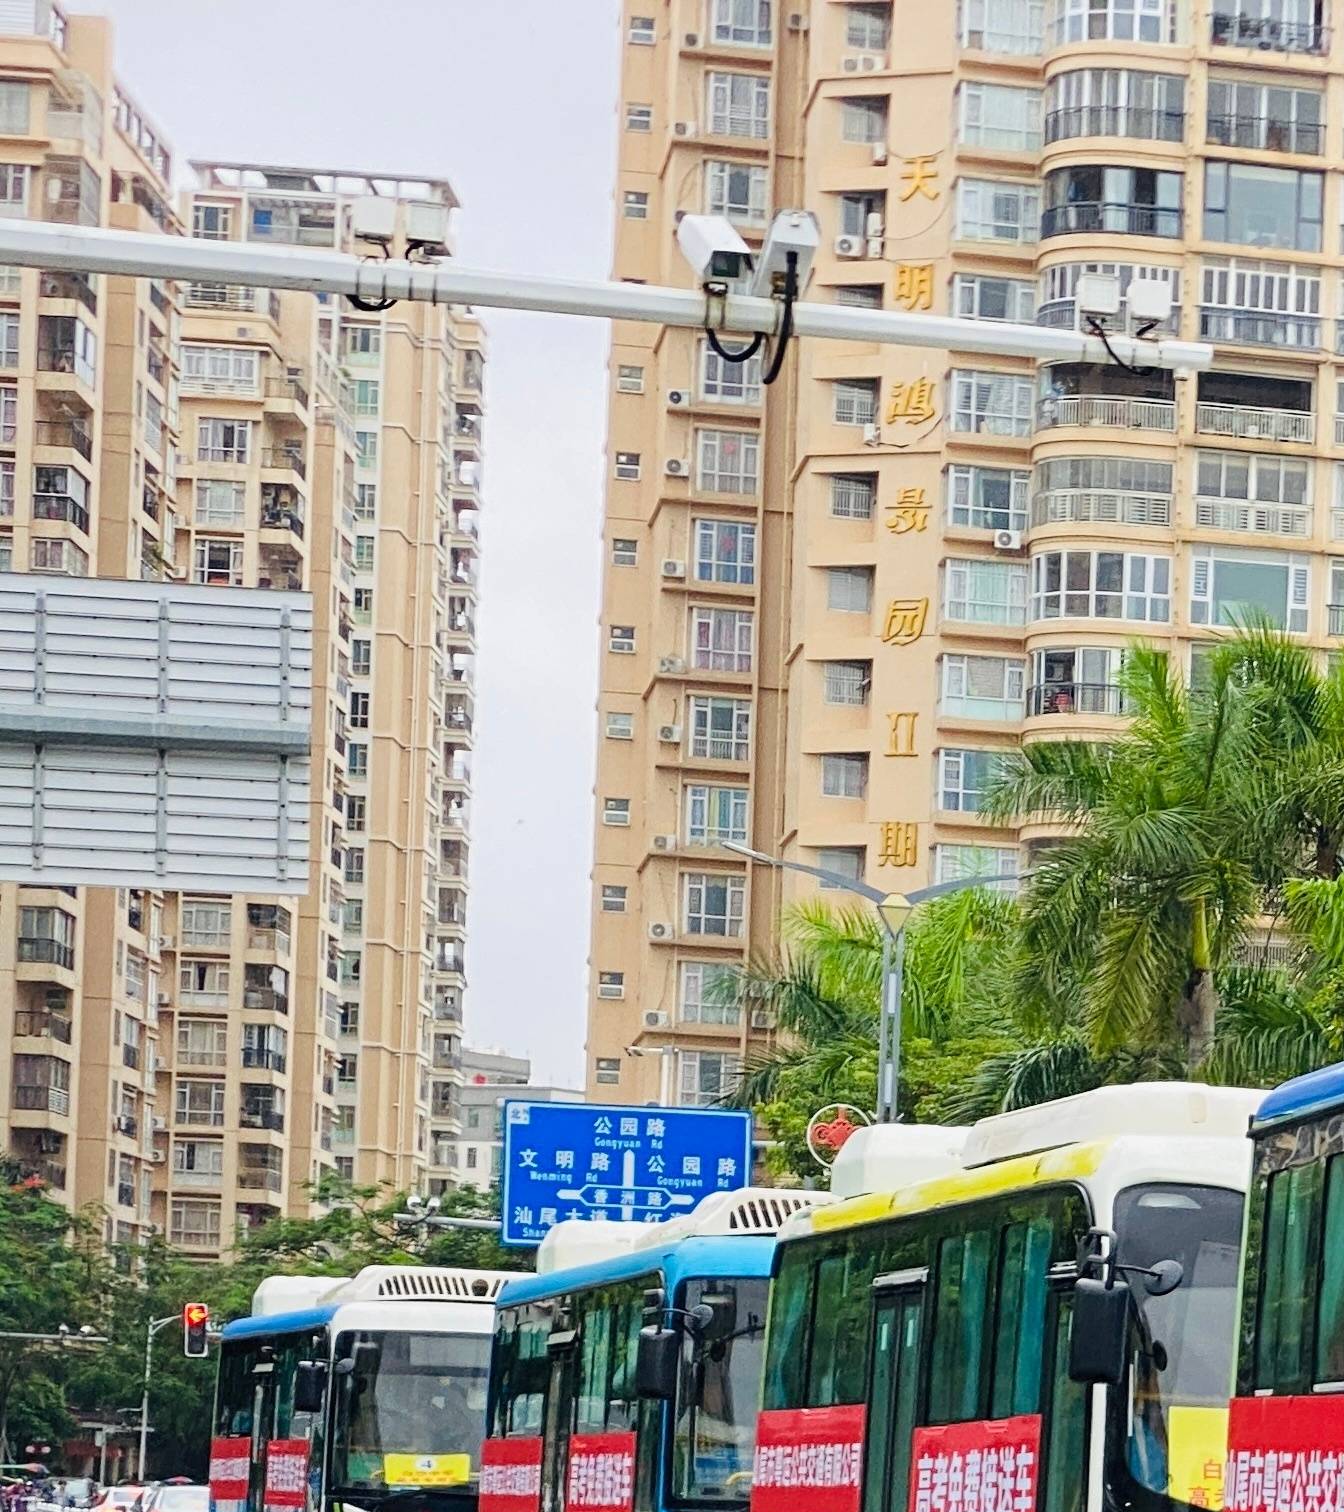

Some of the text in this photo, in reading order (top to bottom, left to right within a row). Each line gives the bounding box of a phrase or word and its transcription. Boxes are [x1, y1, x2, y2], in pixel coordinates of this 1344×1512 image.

[593, 1116, 666, 1137] 公园路
[518, 1149, 610, 1171] 文明路
[647, 1154, 736, 1177] 公园路
[1188, 1486, 1224, 1506] 高
